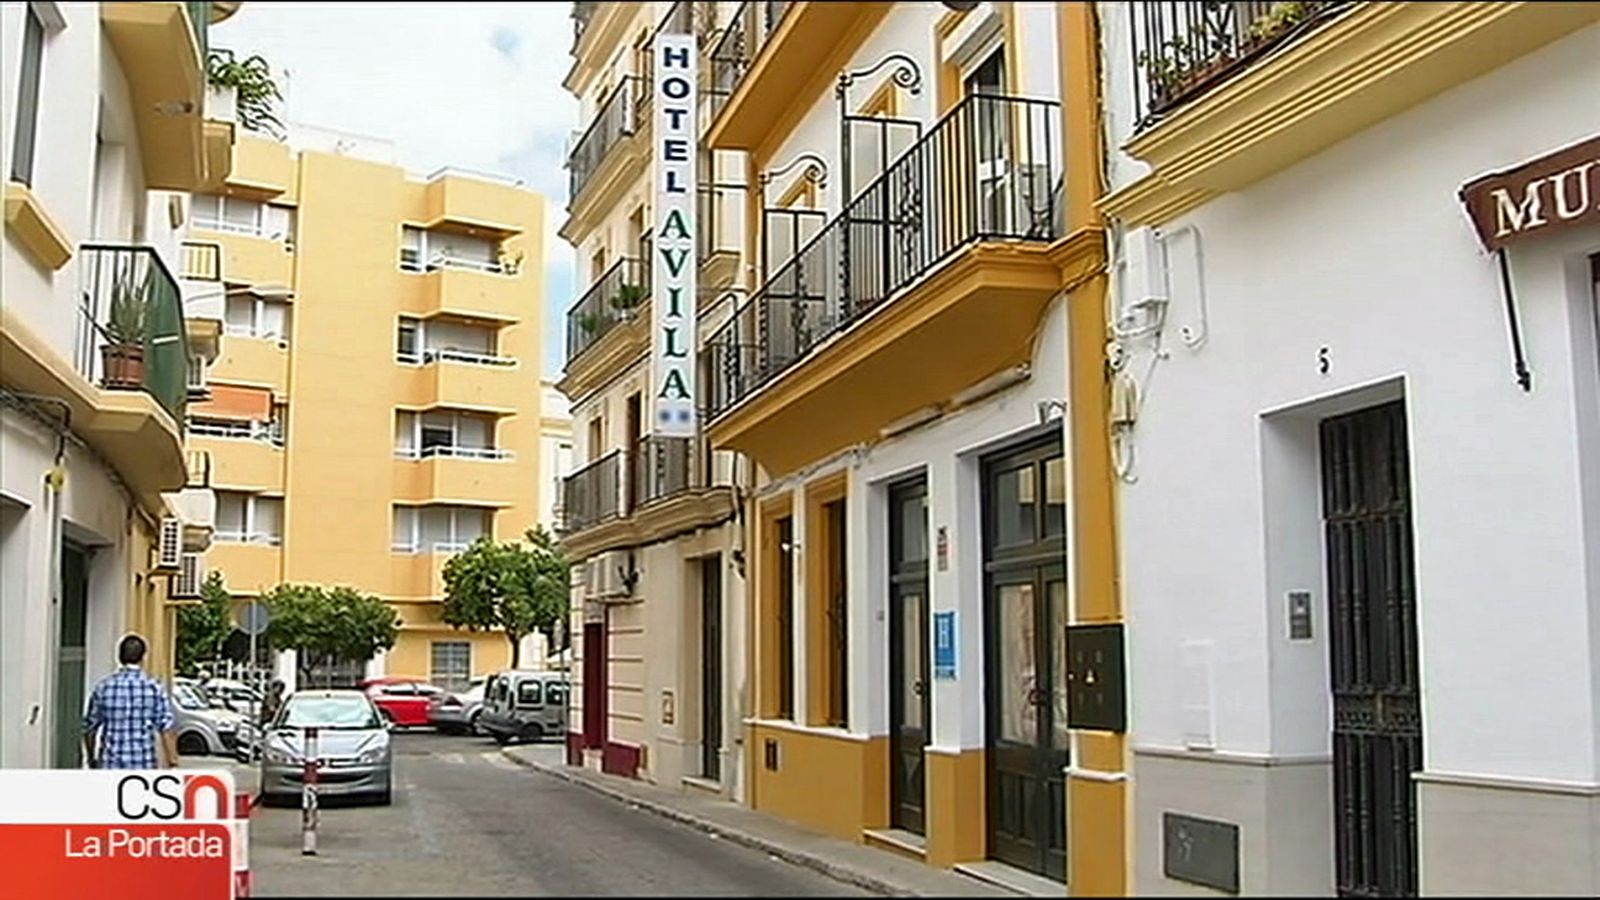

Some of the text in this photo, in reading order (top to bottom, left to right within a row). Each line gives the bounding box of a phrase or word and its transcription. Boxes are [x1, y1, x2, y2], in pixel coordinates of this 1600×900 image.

[658, 46, 691, 399] HOTEL AVILA
[1490, 160, 1600, 238] MU
[1319, 347, 1330, 375] 5
